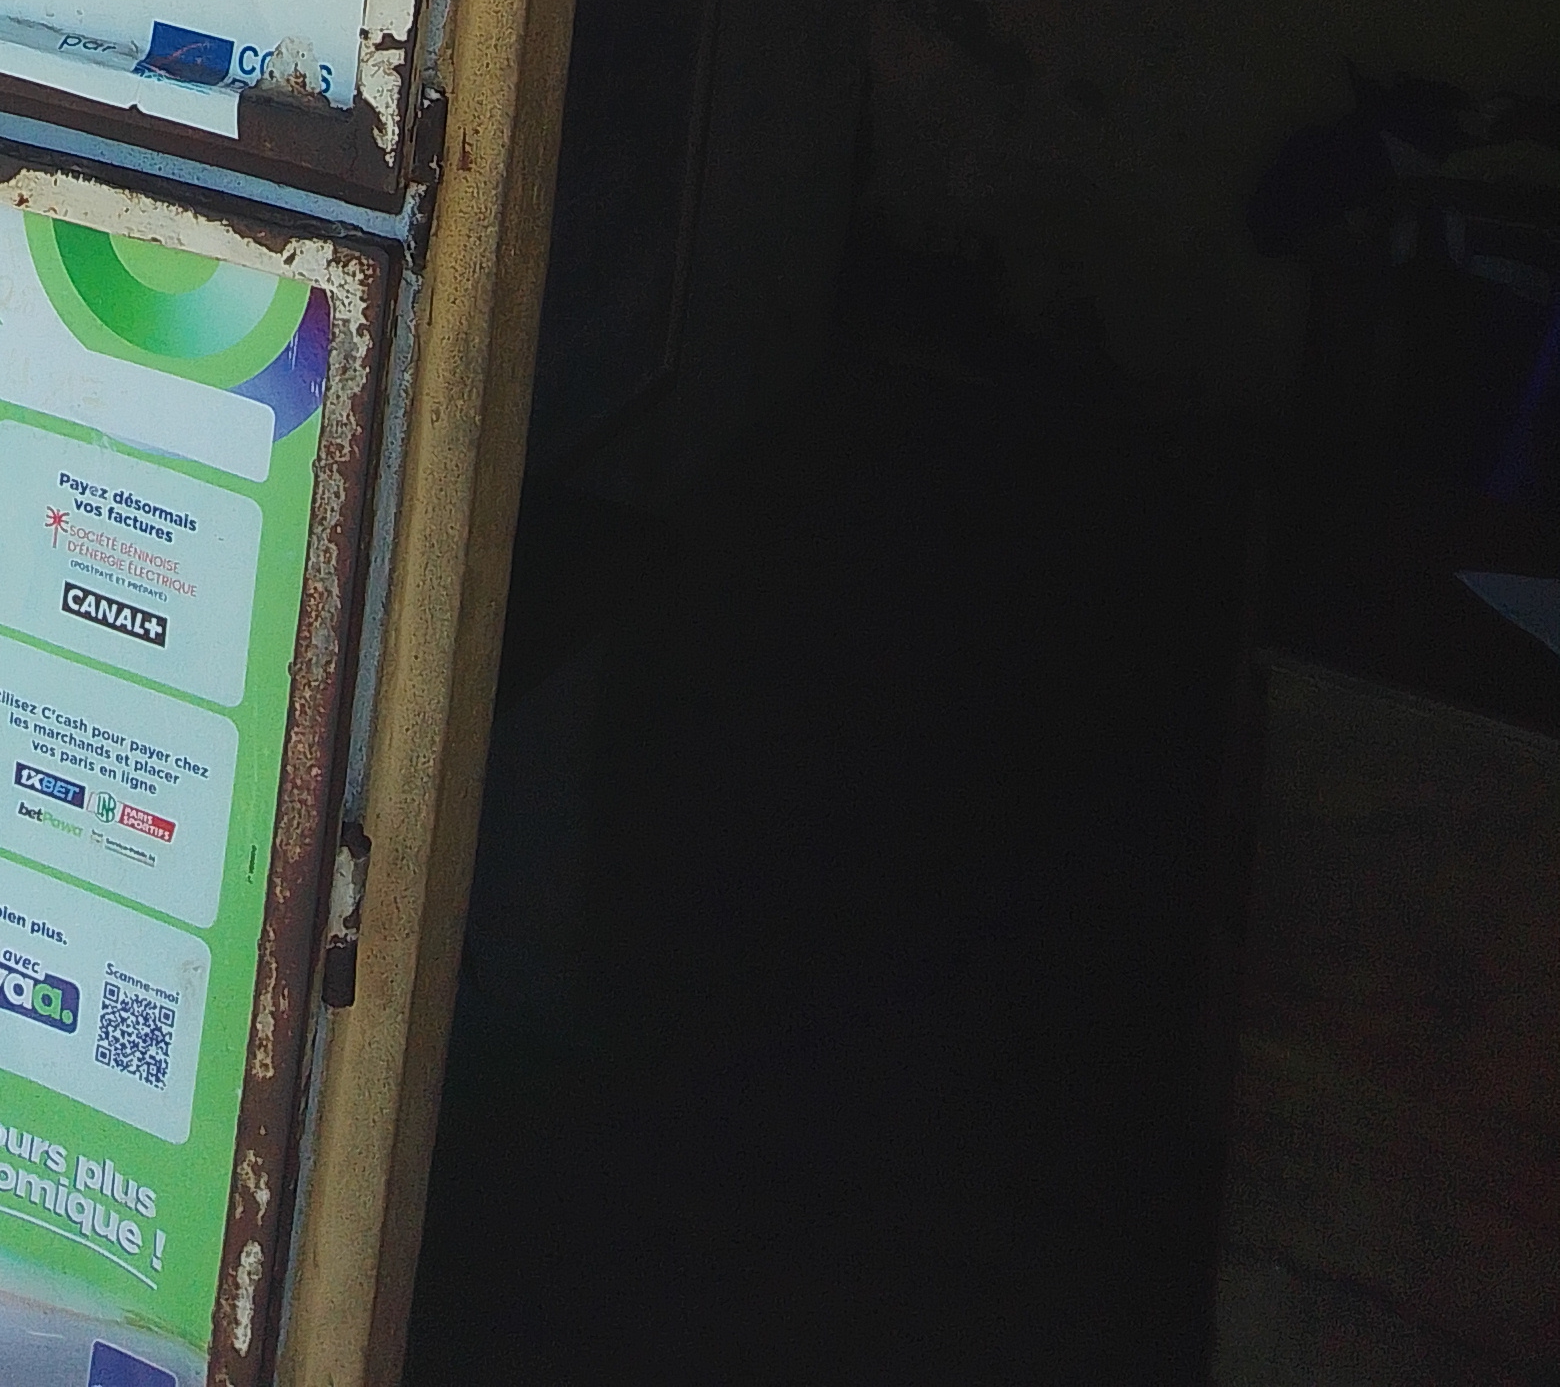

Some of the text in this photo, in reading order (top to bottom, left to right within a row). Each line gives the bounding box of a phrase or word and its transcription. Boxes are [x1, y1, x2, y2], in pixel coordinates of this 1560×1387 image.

[58, 34, 117, 53] par
[59, 471, 197, 531] Payez désormais
[74, 498, 173, 543] vos factures
[67, 540, 197, 597] D'ÉNERGIE ÉLECTRIQUE
[70, 525, 179, 574] SOCIÉTÉ BÉNINOISE
[67, 588, 162, 639] CANAL+
[9, 712, 180, 786] les marchands et placer
[42, 706, 87, 733] C'cash
[92, 727, 126, 749] pour
[130, 740, 170, 764] payer
[175, 754, 208, 778] chez
[31, 740, 157, 795] vos paris en ligne
[18, 802, 83, 838] betPawa
[123, 815, 170, 841] SPORTIFS
[125, 806, 153, 825] PARIS
[30, 919, 68, 945] plus.
[3, 949, 40, 973] avec
[106, 963, 180, 1004] Scanne-moi
[74, 1155, 157, 1218] plus
[151, 1229, 166, 1271] !
